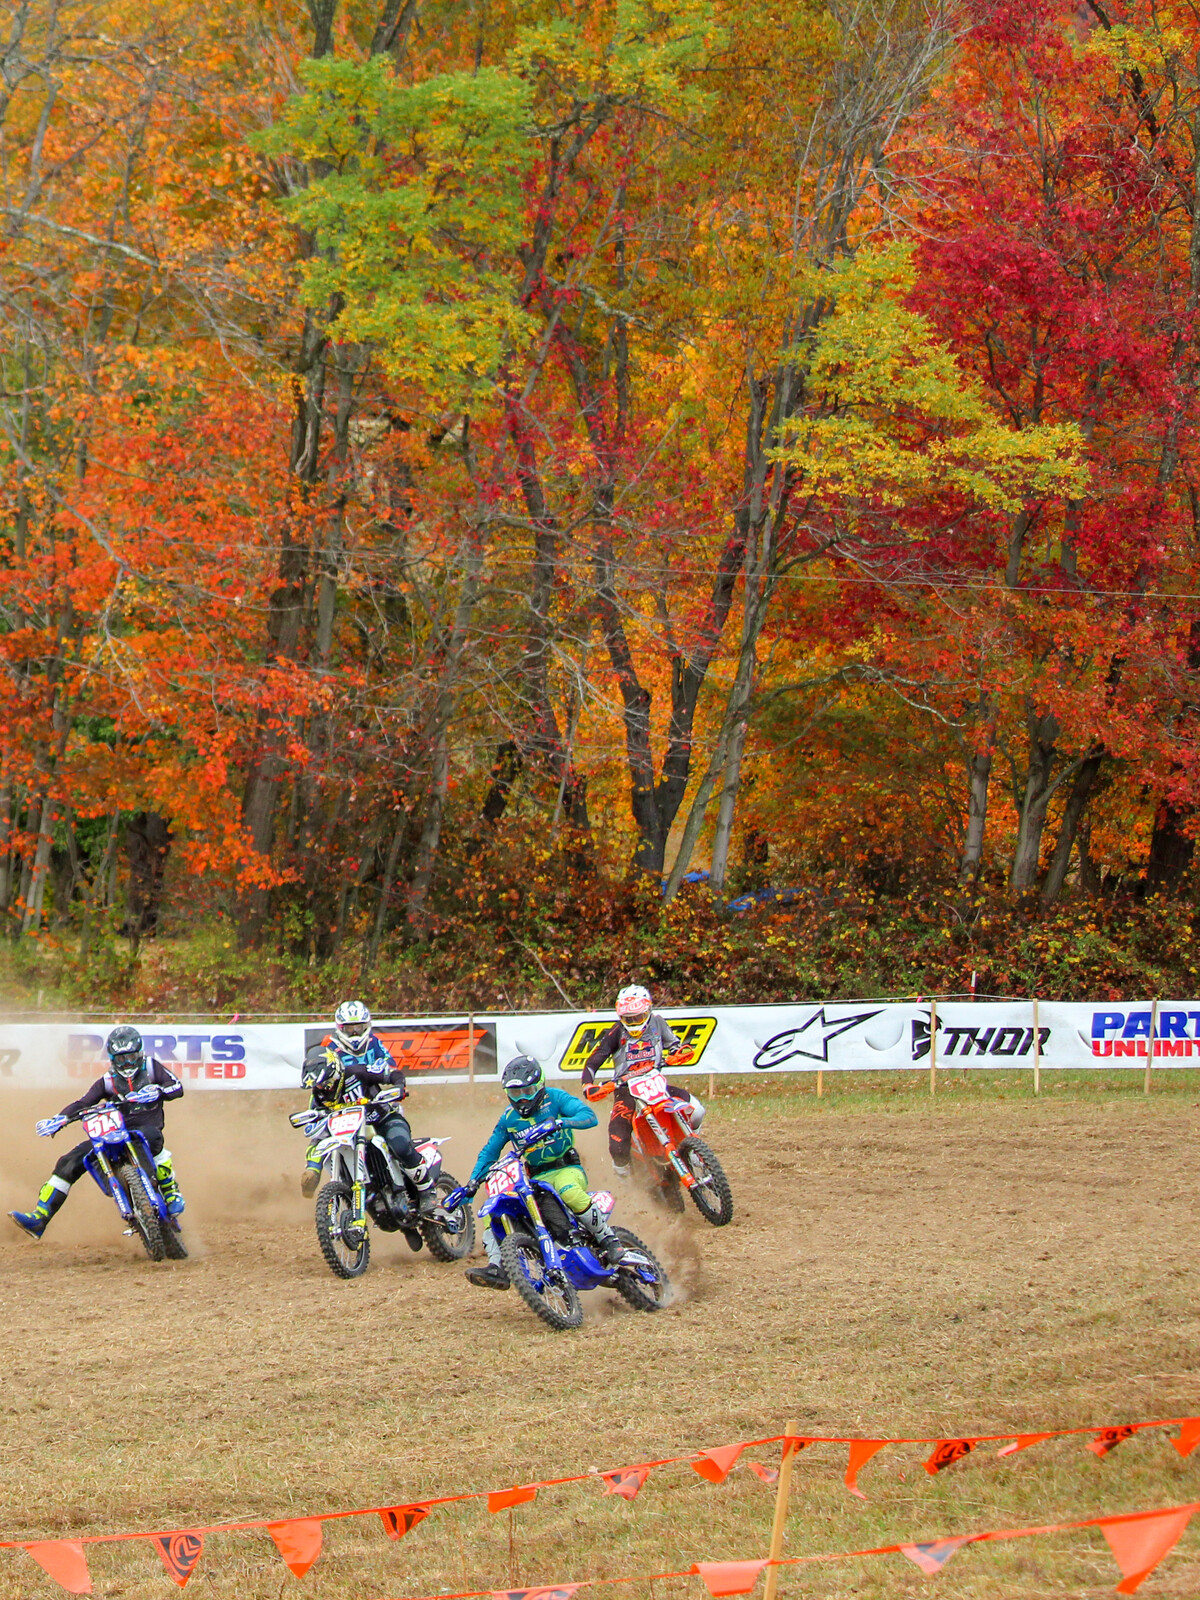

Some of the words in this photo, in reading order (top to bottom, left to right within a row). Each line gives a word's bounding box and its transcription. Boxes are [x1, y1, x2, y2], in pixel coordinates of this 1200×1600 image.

[68, 1034, 246, 1061] PRTS
[943, 1027, 1051, 1056] THOR
[396, 1055, 470, 1070] ACING
[636, 1075, 665, 1101] 530
[86, 1110, 121, 1139] 514
[330, 1112, 361, 1133] 989
[487, 1161, 521, 1198] 523
